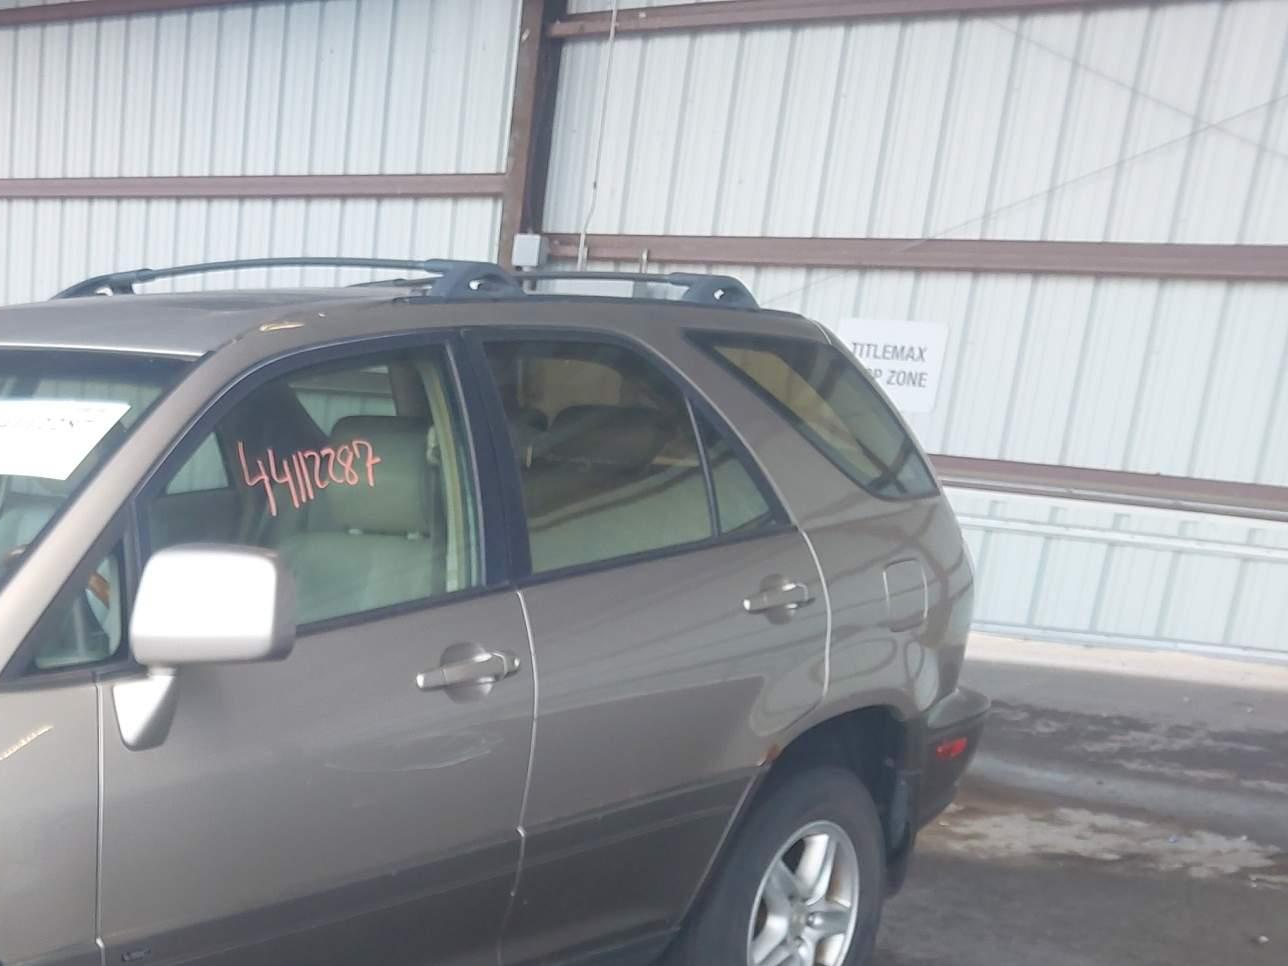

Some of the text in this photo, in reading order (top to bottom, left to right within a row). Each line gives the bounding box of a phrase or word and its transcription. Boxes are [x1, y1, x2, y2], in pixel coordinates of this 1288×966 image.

[852, 342, 928, 362] TITLEMAX
[886, 369, 928, 388] ZONE
[237, 440, 382, 517] 44112287
